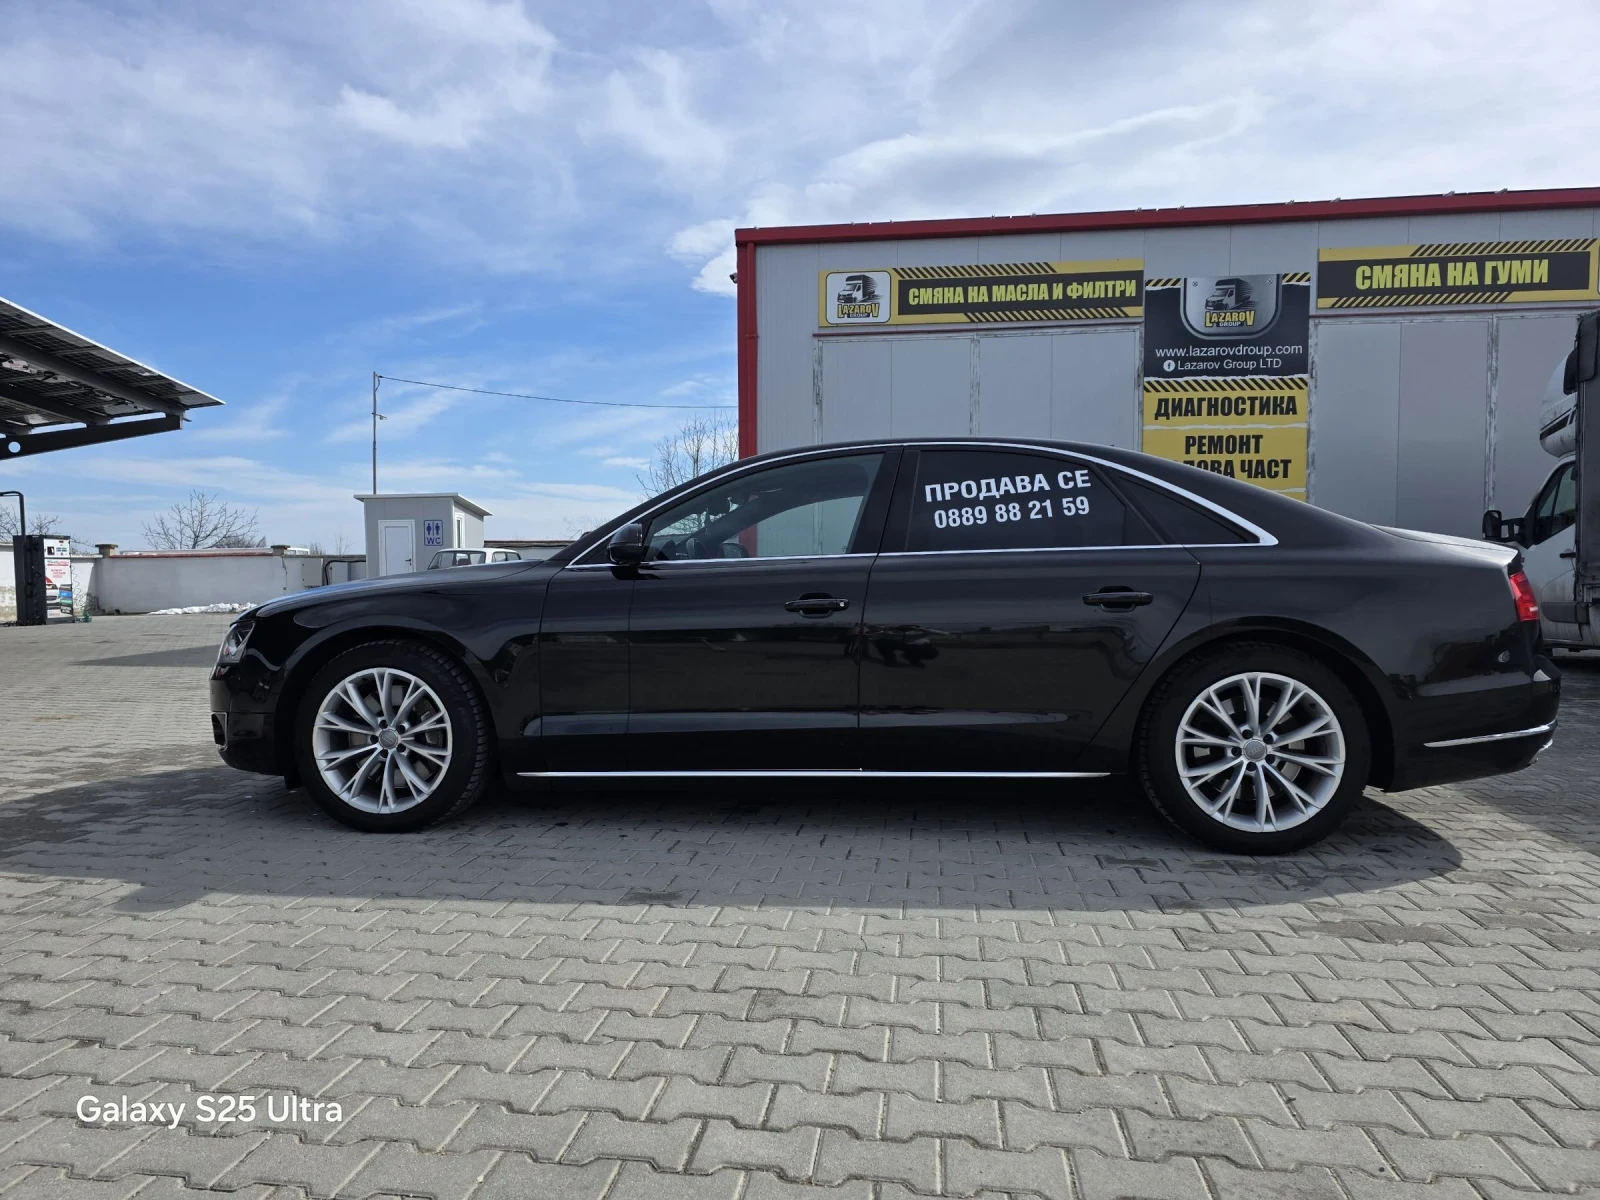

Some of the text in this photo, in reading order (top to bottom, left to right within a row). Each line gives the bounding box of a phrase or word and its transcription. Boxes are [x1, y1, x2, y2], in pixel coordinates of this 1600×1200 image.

[1355, 259, 1549, 290] СМЯНА НА ГУМИ
[908, 279, 1137, 306] СМЯНА НА МАСЛА И ФИЛТРИ
[837, 303, 880, 318] LAZAROV
[1205, 310, 1255, 327] LAZAROV
[1155, 344, 1303, 358] www.lazarovdroup.com
[1177, 360, 1221, 370] Lazarov
[1223, 359, 1257, 371] Group
[1259, 358, 1282, 368] LTD
[1154, 396, 1298, 420] ДИАГНОСТИКА
[1184, 434, 1264, 455] РЕМОНТ
[1240, 459, 1292, 479] ЧАСТ
[924, 469, 1092, 502] ПРОДАВА СЕ
[934, 496, 1090, 529] 0889 88 21 59
[426, 537, 441, 545] WC
